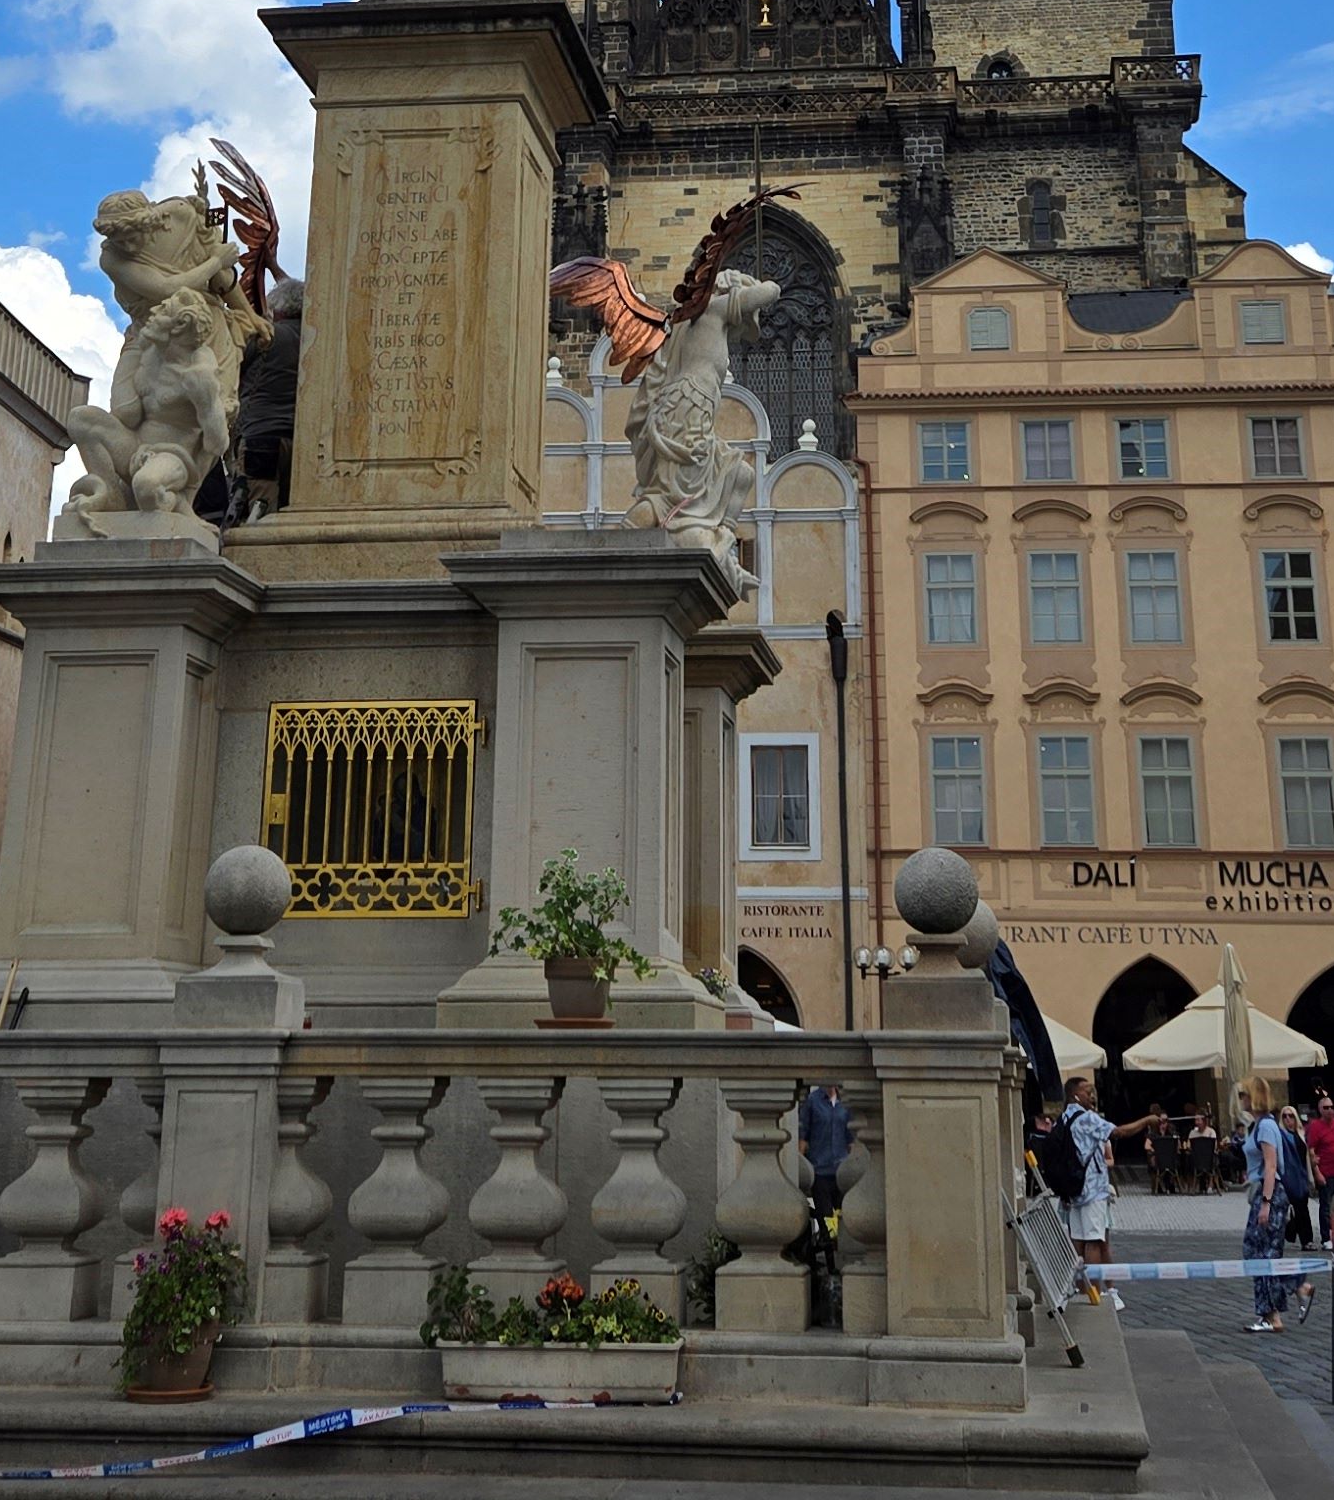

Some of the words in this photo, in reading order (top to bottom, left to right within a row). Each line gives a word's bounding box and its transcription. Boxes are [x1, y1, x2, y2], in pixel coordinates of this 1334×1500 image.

[396, 206, 428, 223] SINE
[398, 292, 415, 305] ET
[410, 334, 446, 347] ERGO
[386, 378, 403, 391] ET
[1073, 855, 1137, 887] DALÍ
[1218, 861, 1329, 887] MUCHA
[743, 905, 825, 916] RISTORANTE
[740, 927, 783, 938] CAFFE
[788, 927, 833, 938] ITALIA
[1077, 923, 1133, 944] CAFÉ
[1139, 926, 1155, 944] U
[1158, 924, 1220, 945] TÝNA
